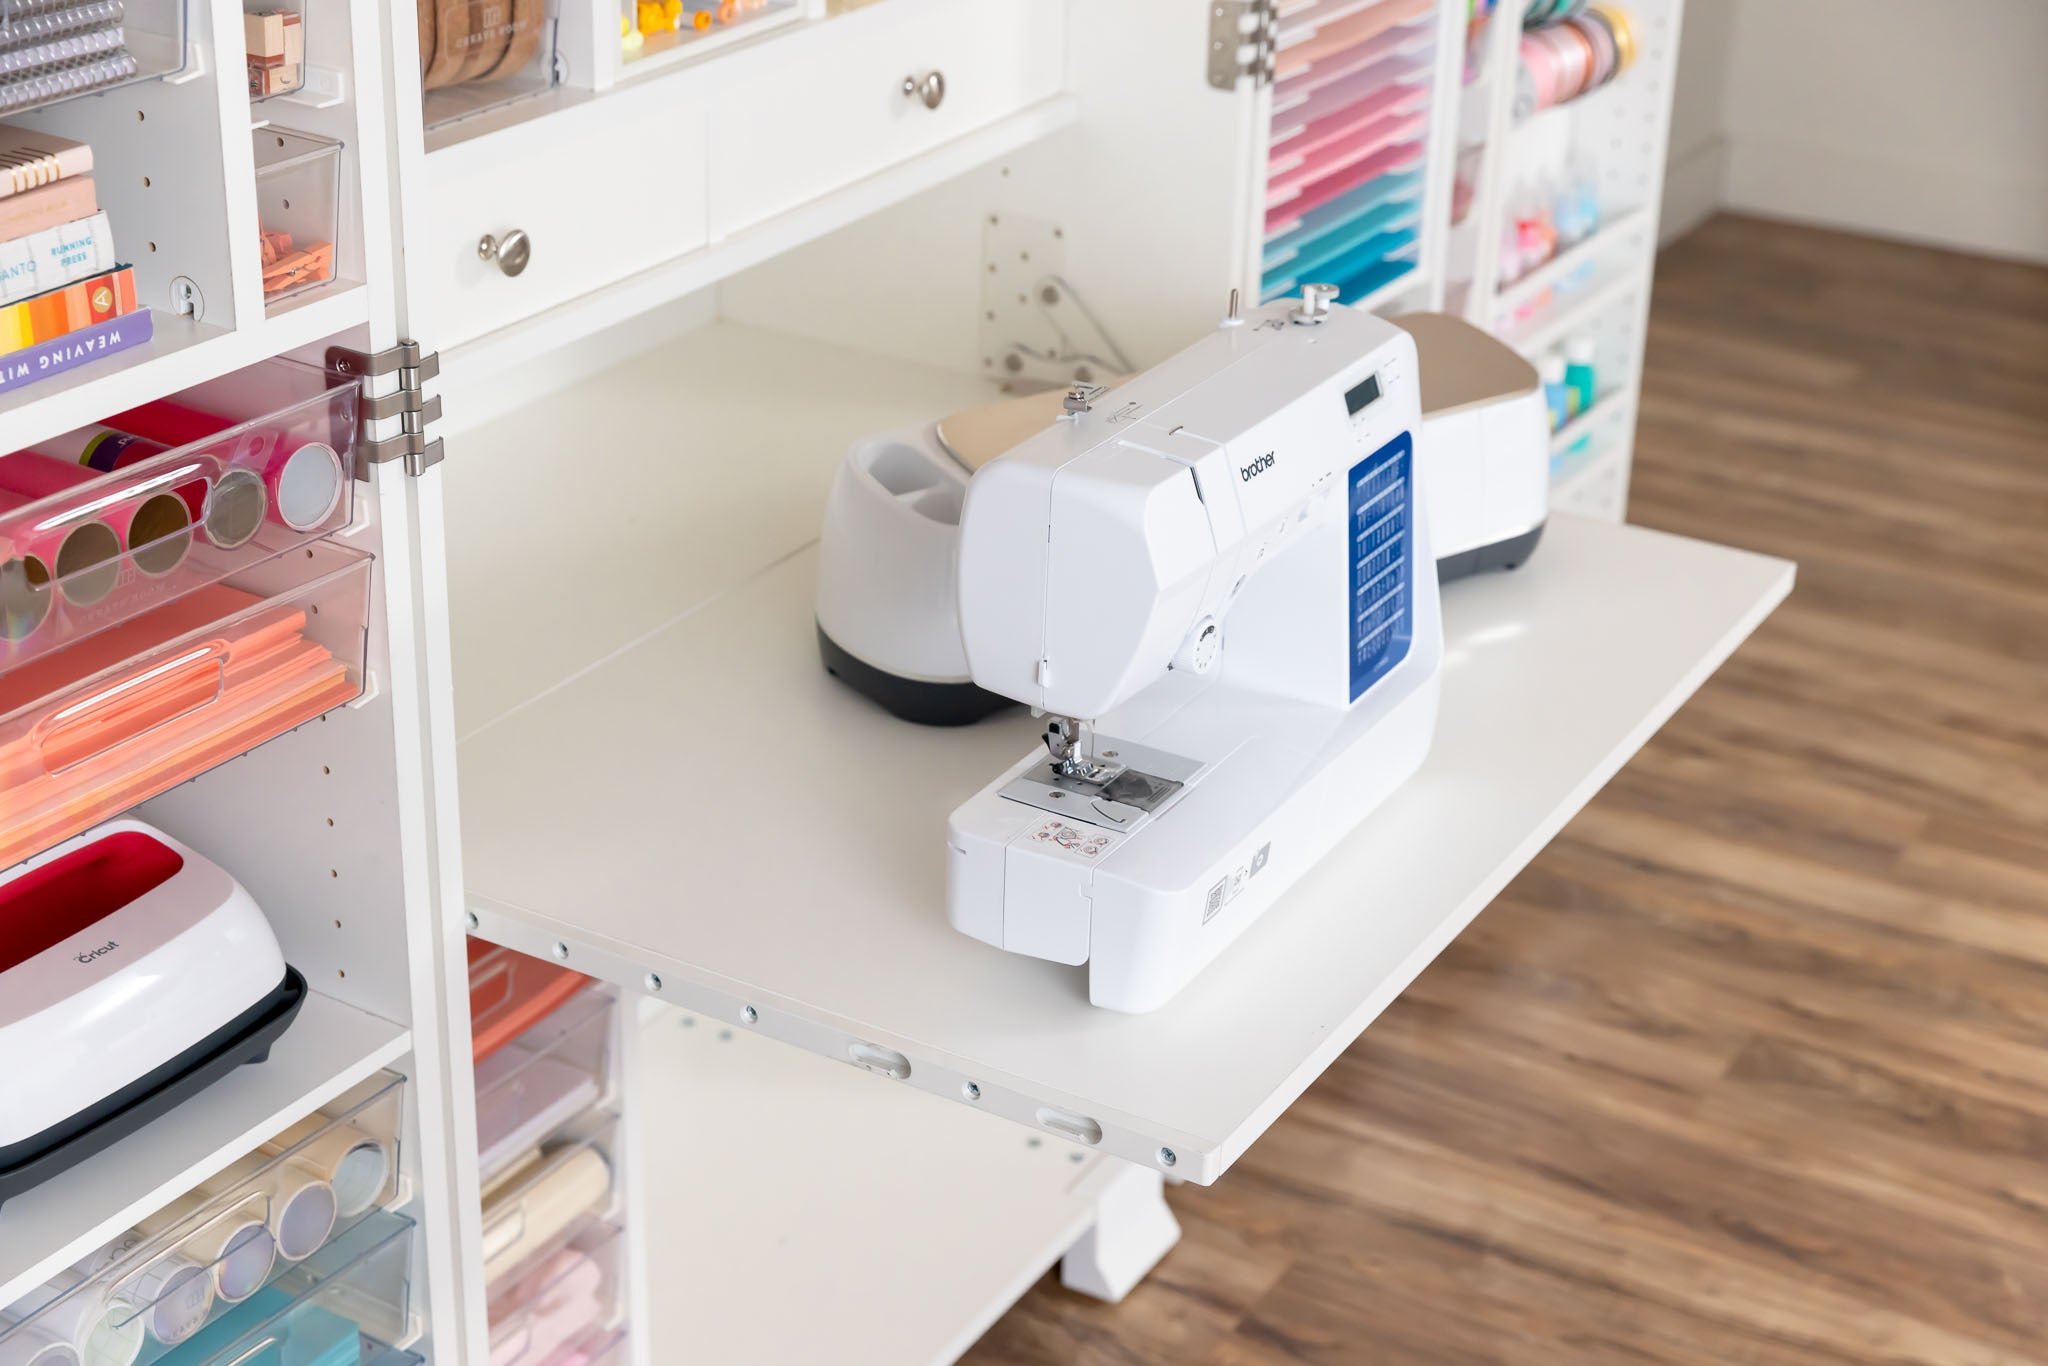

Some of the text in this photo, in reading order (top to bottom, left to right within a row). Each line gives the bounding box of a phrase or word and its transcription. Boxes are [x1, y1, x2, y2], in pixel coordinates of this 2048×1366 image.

[51, 237, 92, 256] RUNNING
[61, 252, 87, 267] PRESS
[39, 330, 121, 369] WEAVING
[1240, 450, 1276, 482] brother
[73, 940, 119, 964] Cricut
